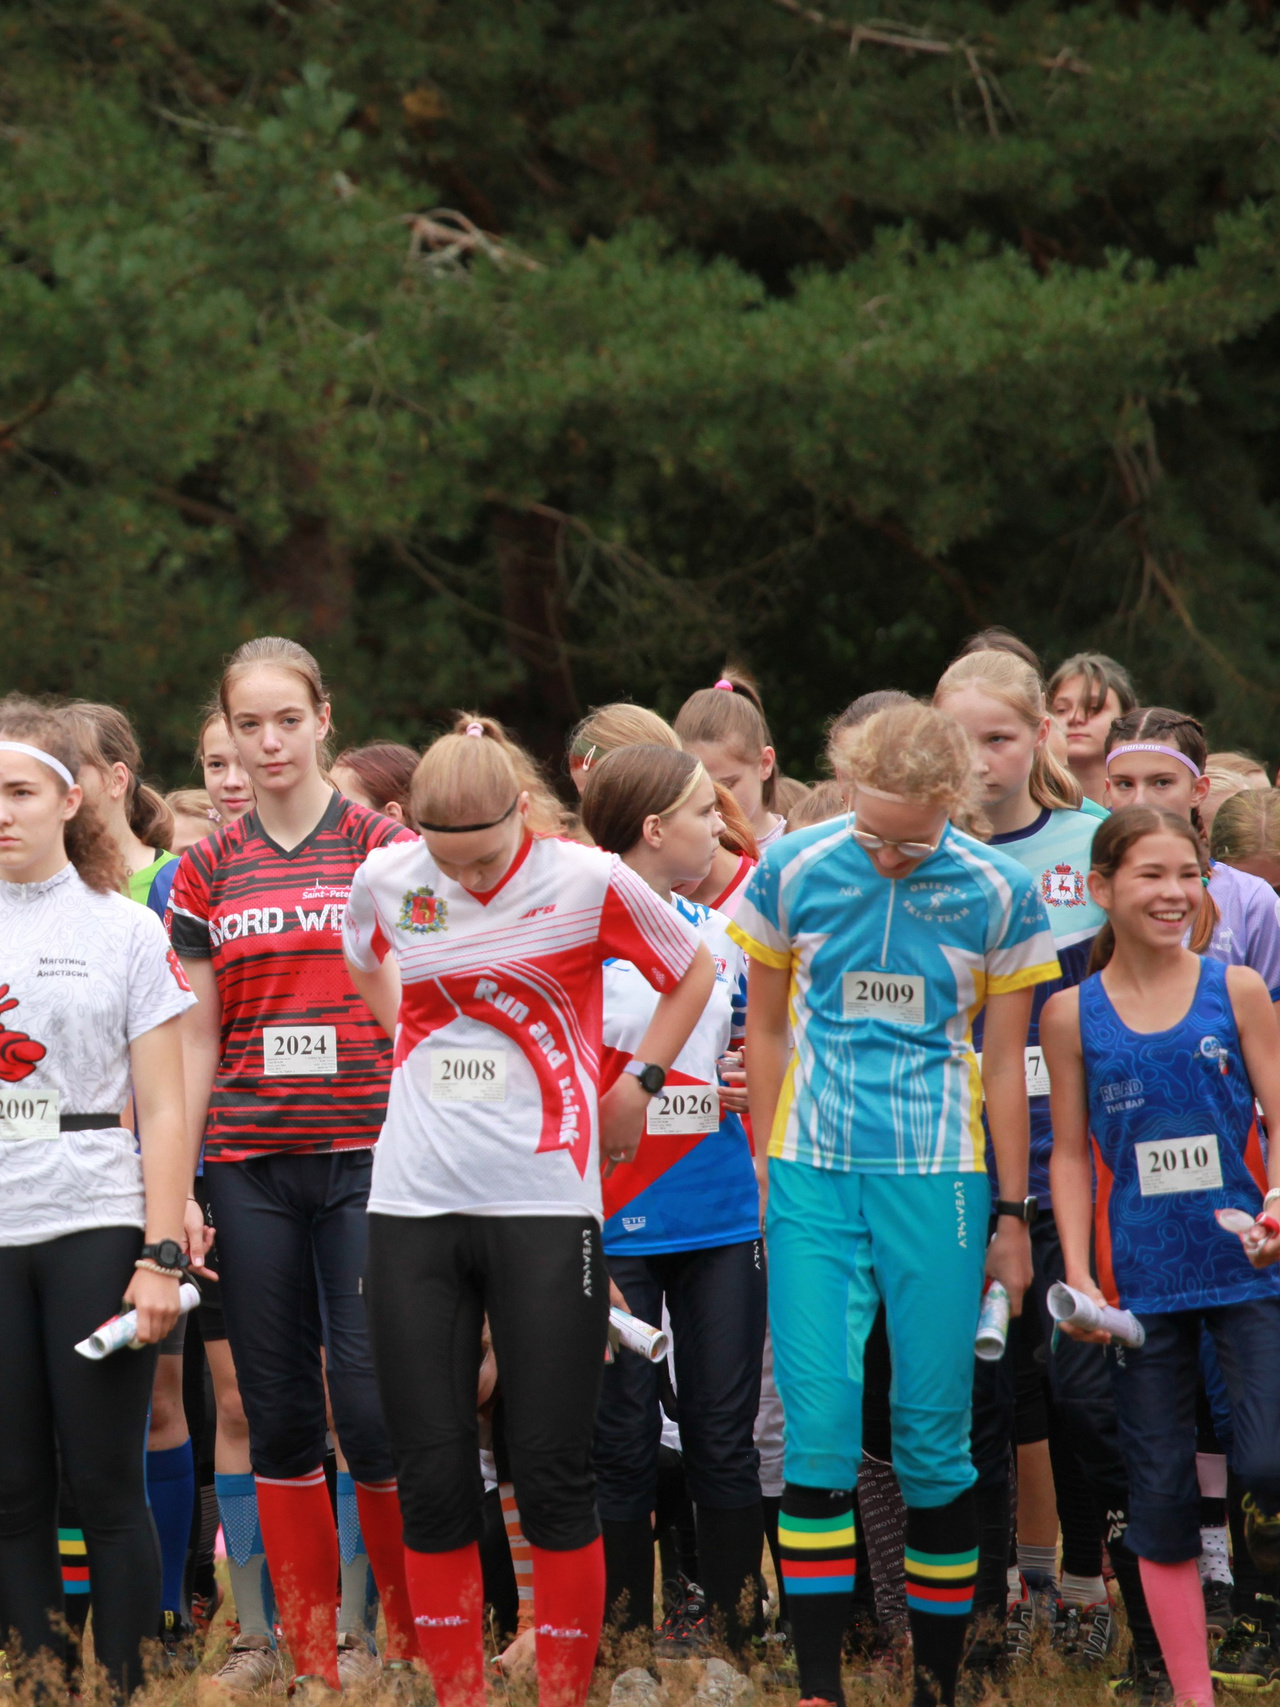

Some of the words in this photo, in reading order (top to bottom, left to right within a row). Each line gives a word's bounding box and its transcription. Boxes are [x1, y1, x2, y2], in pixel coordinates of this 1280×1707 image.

[208, 907, 283, 947] NORD
[40, 957, 87, 966] Мяготина
[37, 969, 89, 978] Анастасия
[856, 980, 914, 1003] 2009
[274, 1035, 326, 1055] 2024
[441, 1059, 496, 1081] 2008
[473, 978, 530, 1023] Run
[529, 1020, 568, 1070] and
[558, 1076, 580, 1147] think
[1100, 1079, 1143, 1102] READ
[658, 1094, 712, 1116] 2026
[1148, 1146, 1209, 1173] 2010
[622, 1216, 646, 1224] STG
